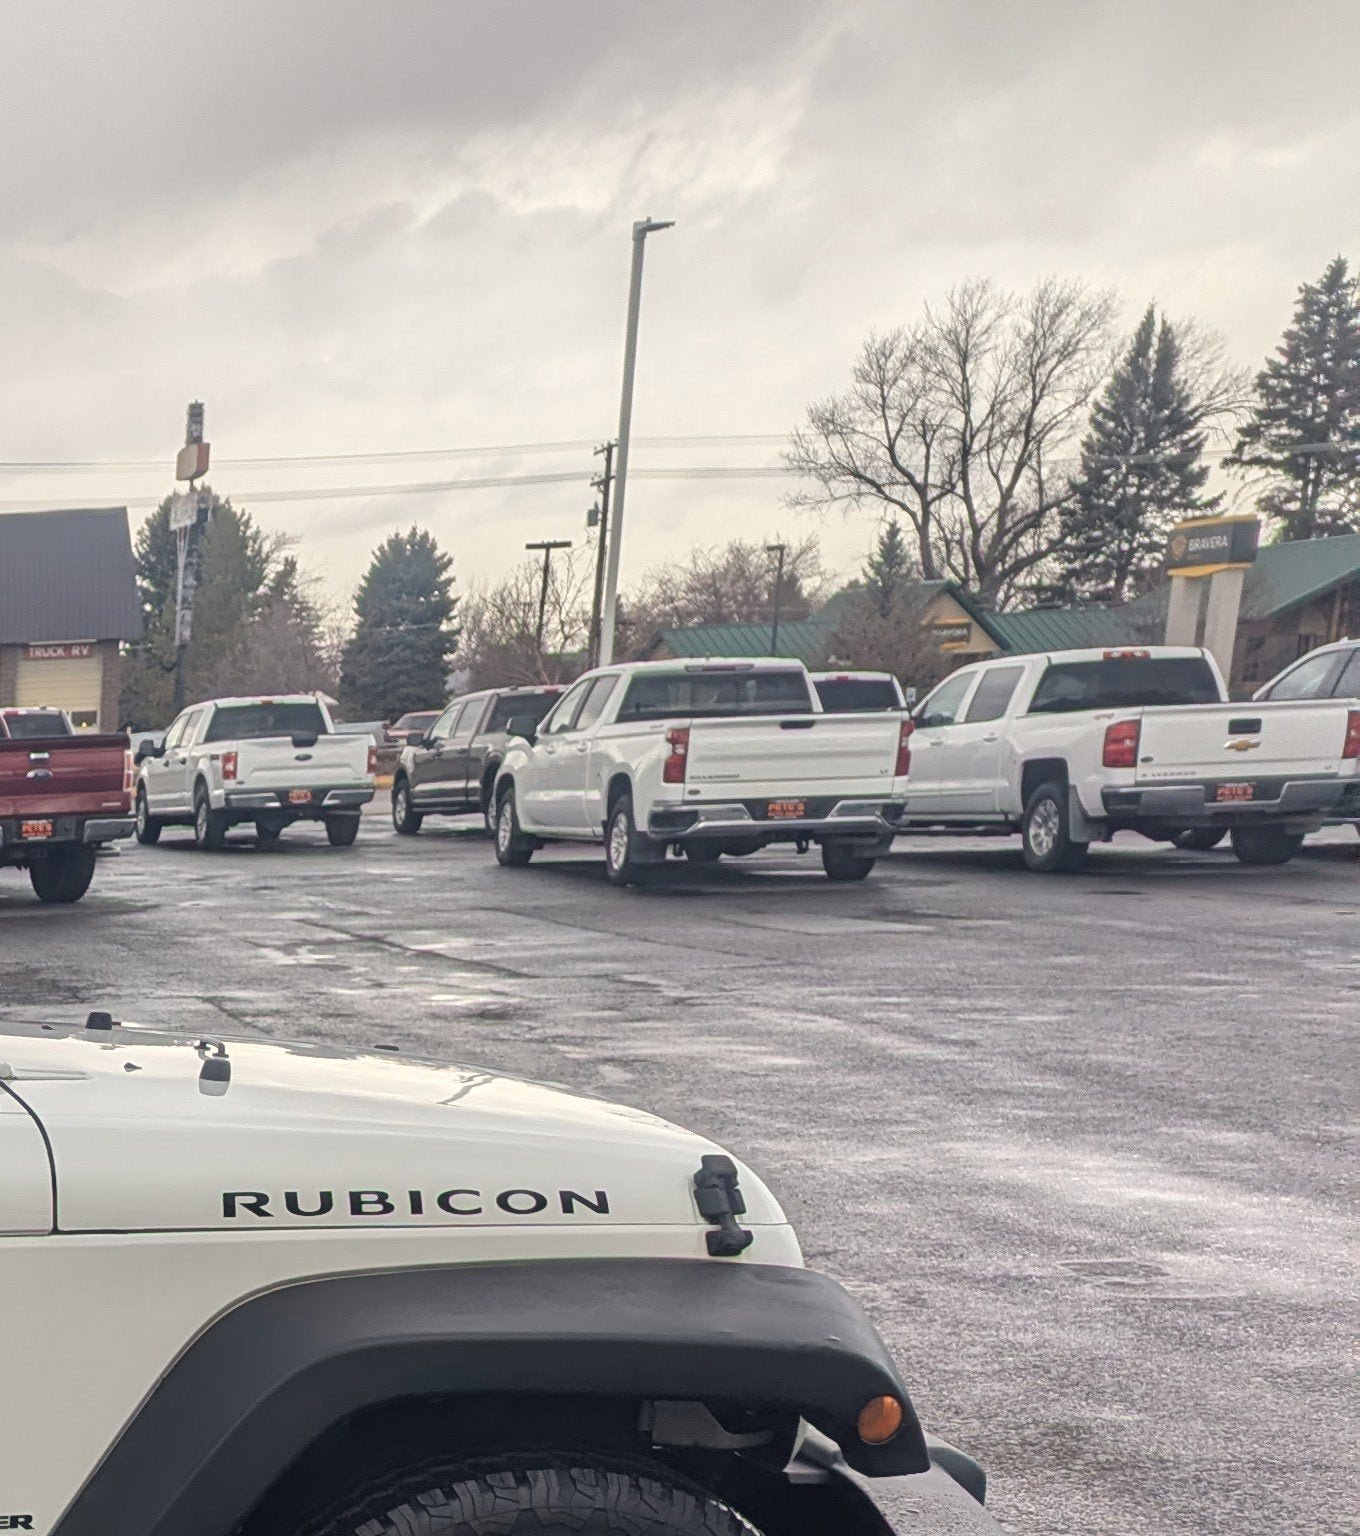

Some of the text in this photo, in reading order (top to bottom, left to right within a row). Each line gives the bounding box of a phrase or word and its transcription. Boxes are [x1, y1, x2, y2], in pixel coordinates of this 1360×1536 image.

[1188, 535, 1228, 551] BRAVERA
[29, 644, 90, 658] TRUCK RV
[221, 1188, 611, 1219] RUBICON
